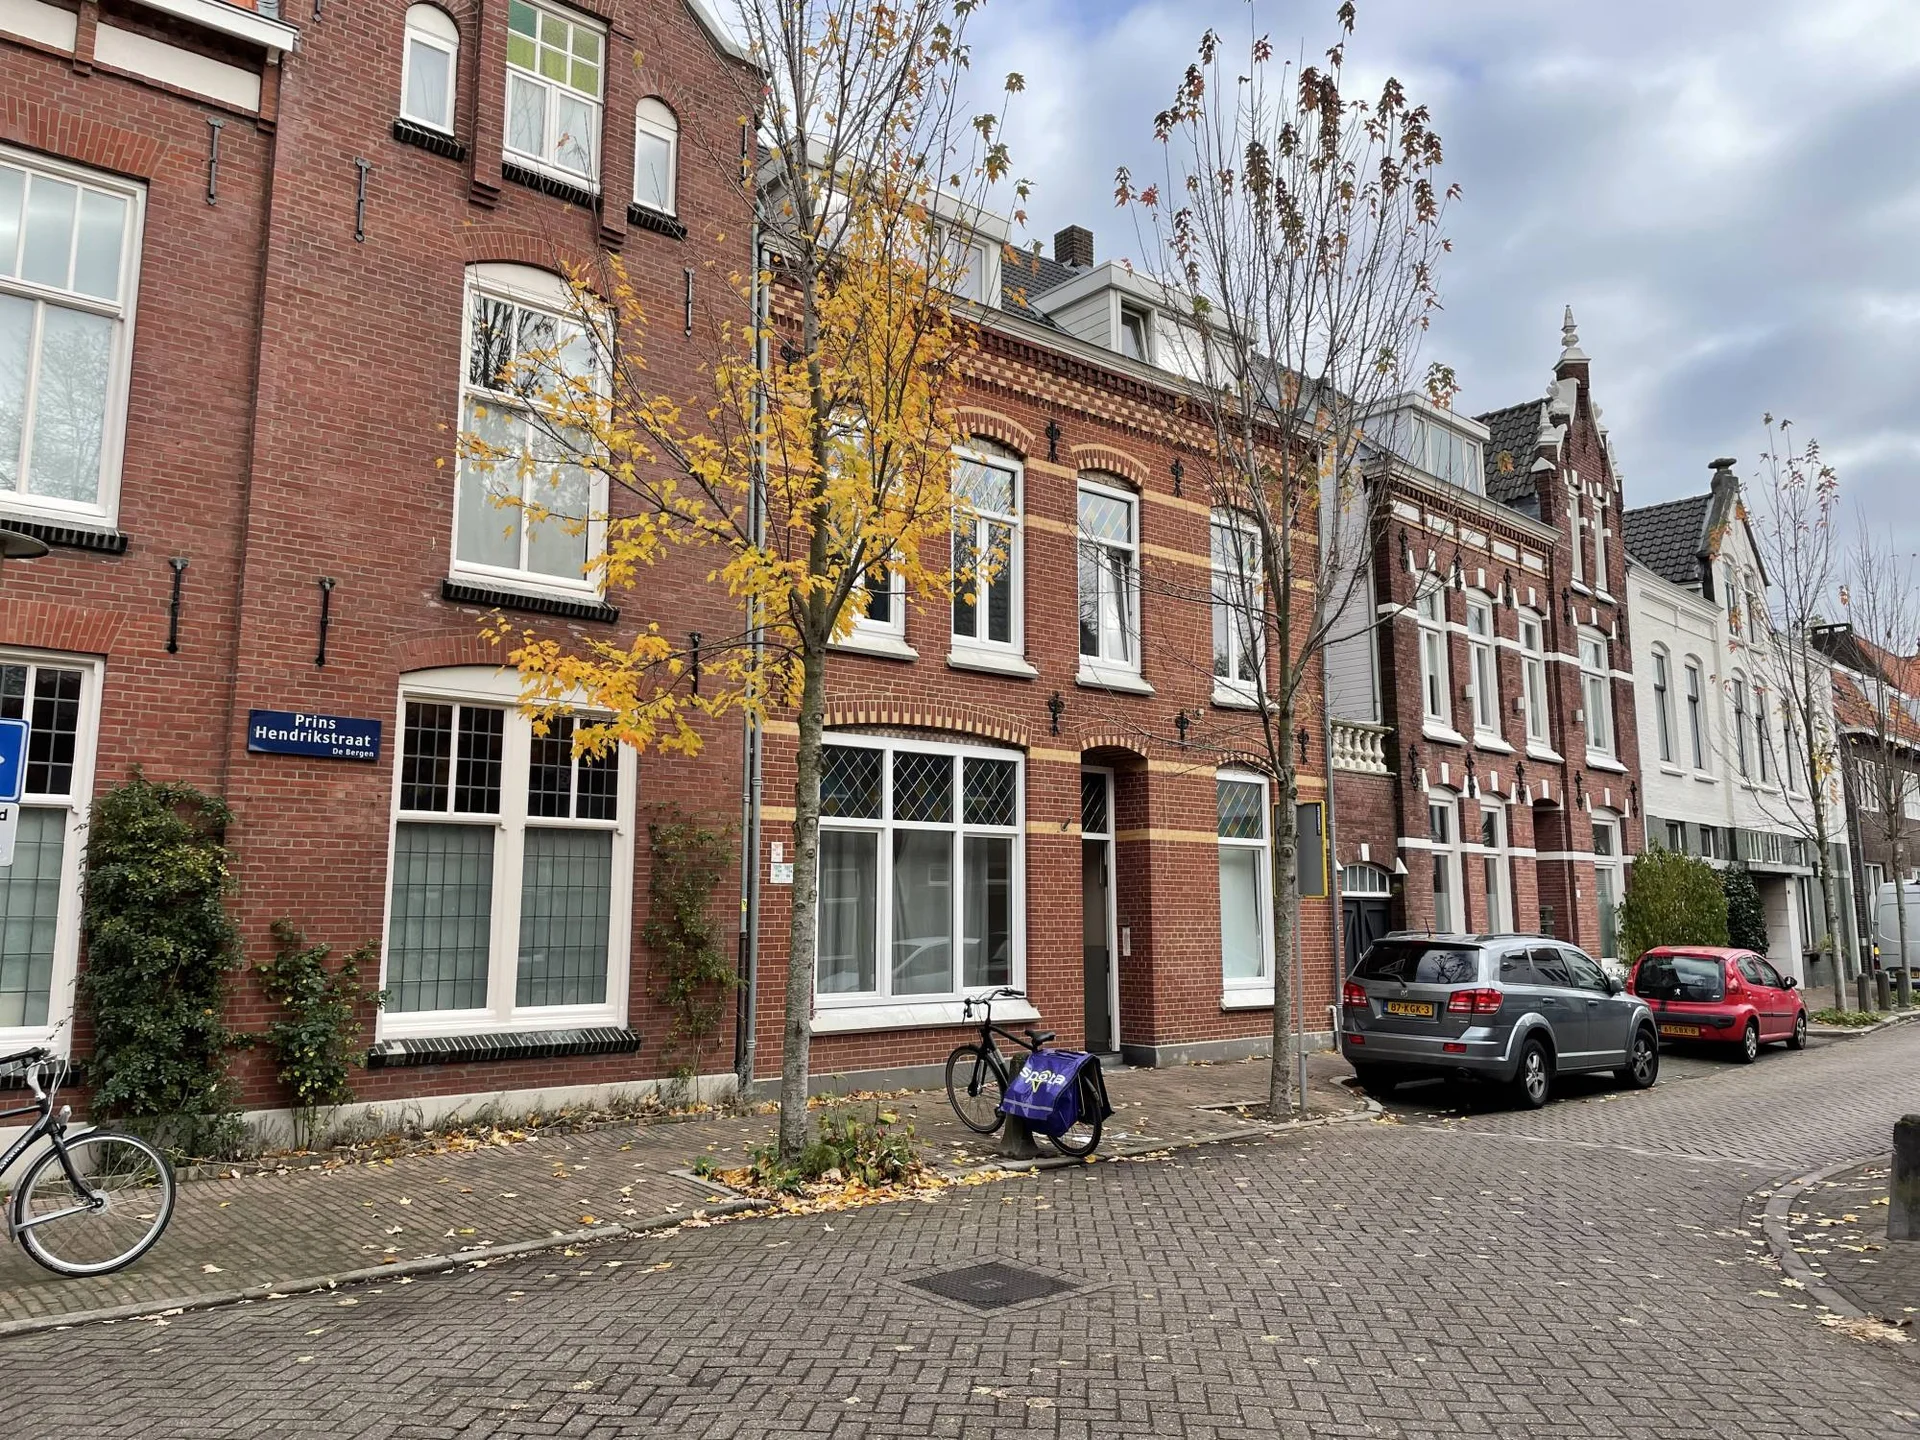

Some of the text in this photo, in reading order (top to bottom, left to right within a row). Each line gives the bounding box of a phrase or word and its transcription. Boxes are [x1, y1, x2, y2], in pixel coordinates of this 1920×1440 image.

[294, 713, 337, 730] Prins
[254, 725, 372, 747] Hendrikstraat
[332, 747, 375, 758] De Bergen
[1390, 1003, 1430, 1015] 87-KGK-3
